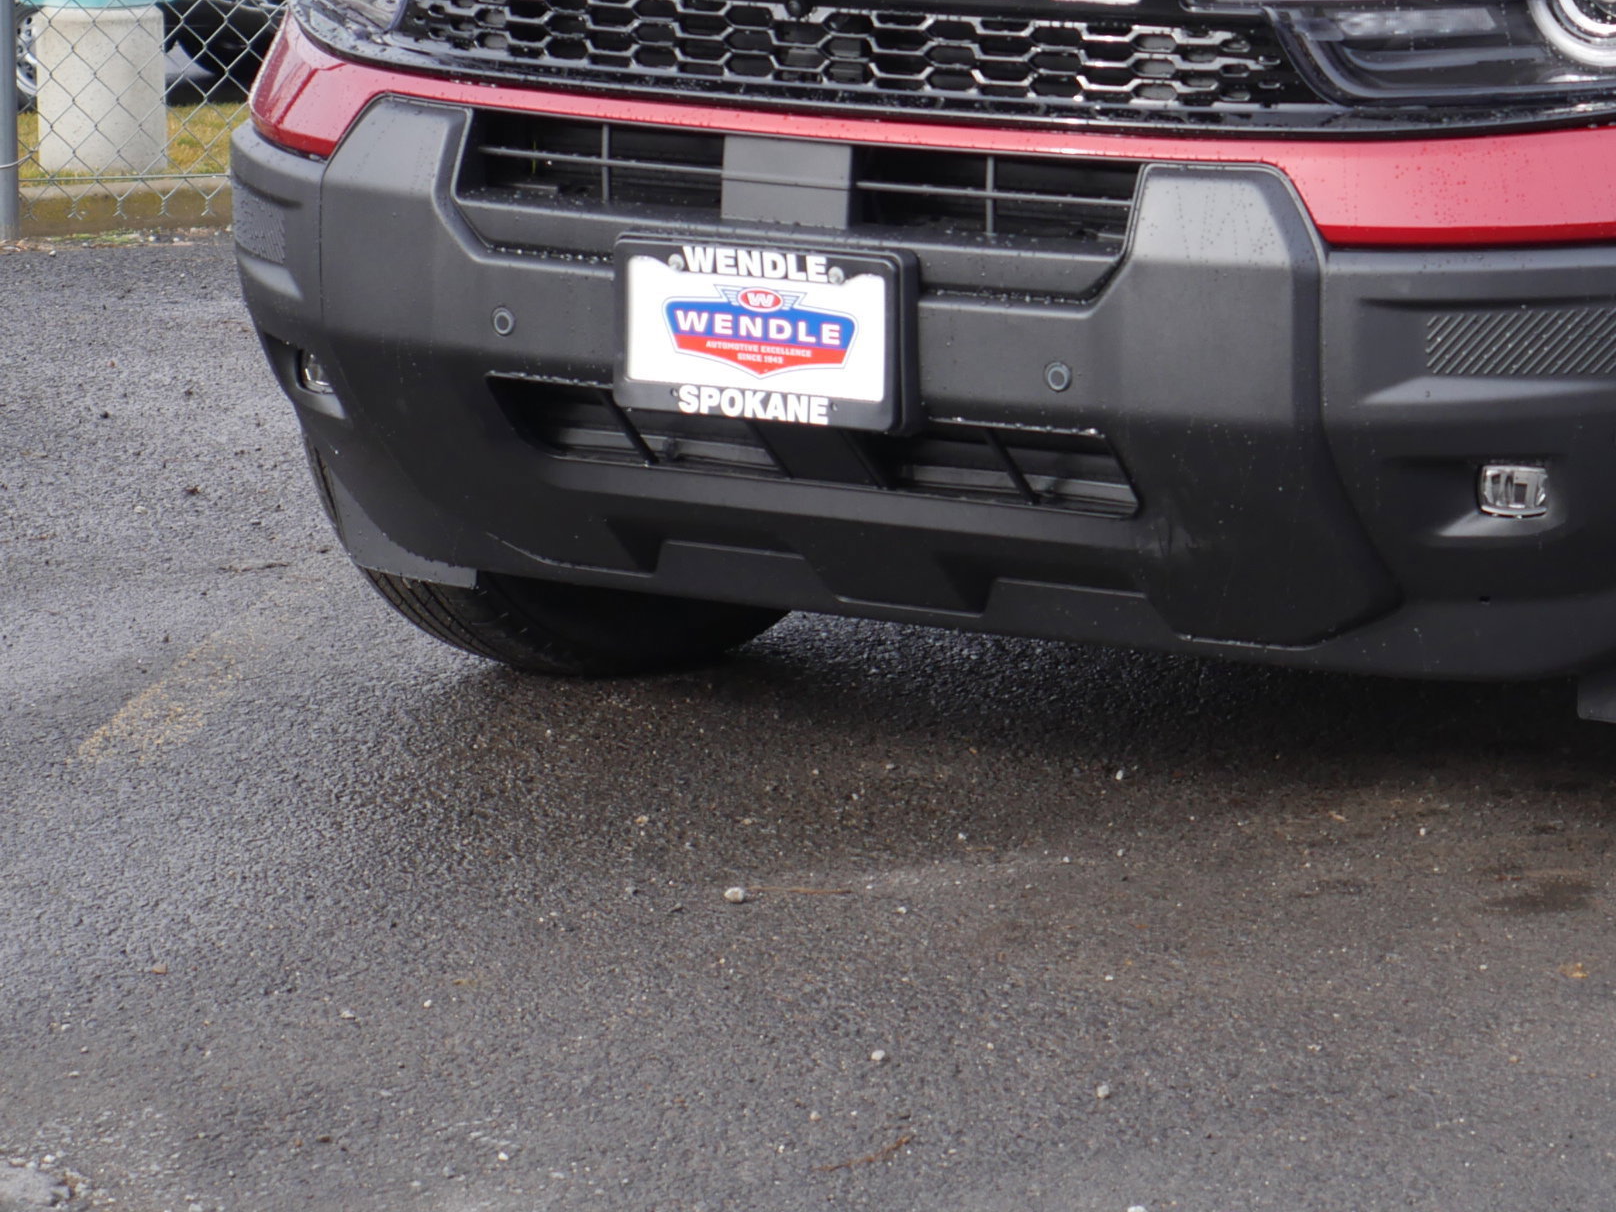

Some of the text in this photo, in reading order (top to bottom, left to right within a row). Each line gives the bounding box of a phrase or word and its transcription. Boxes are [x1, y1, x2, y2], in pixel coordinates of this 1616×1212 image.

[682, 245, 829, 284] WENDLE
[675, 309, 841, 345] WENDLE
[705, 340, 812, 358] AUTOMOTIVE EXCELLENCE
[737, 352, 784, 365] SINCE 1943
[678, 385, 830, 425] SPOKANE
